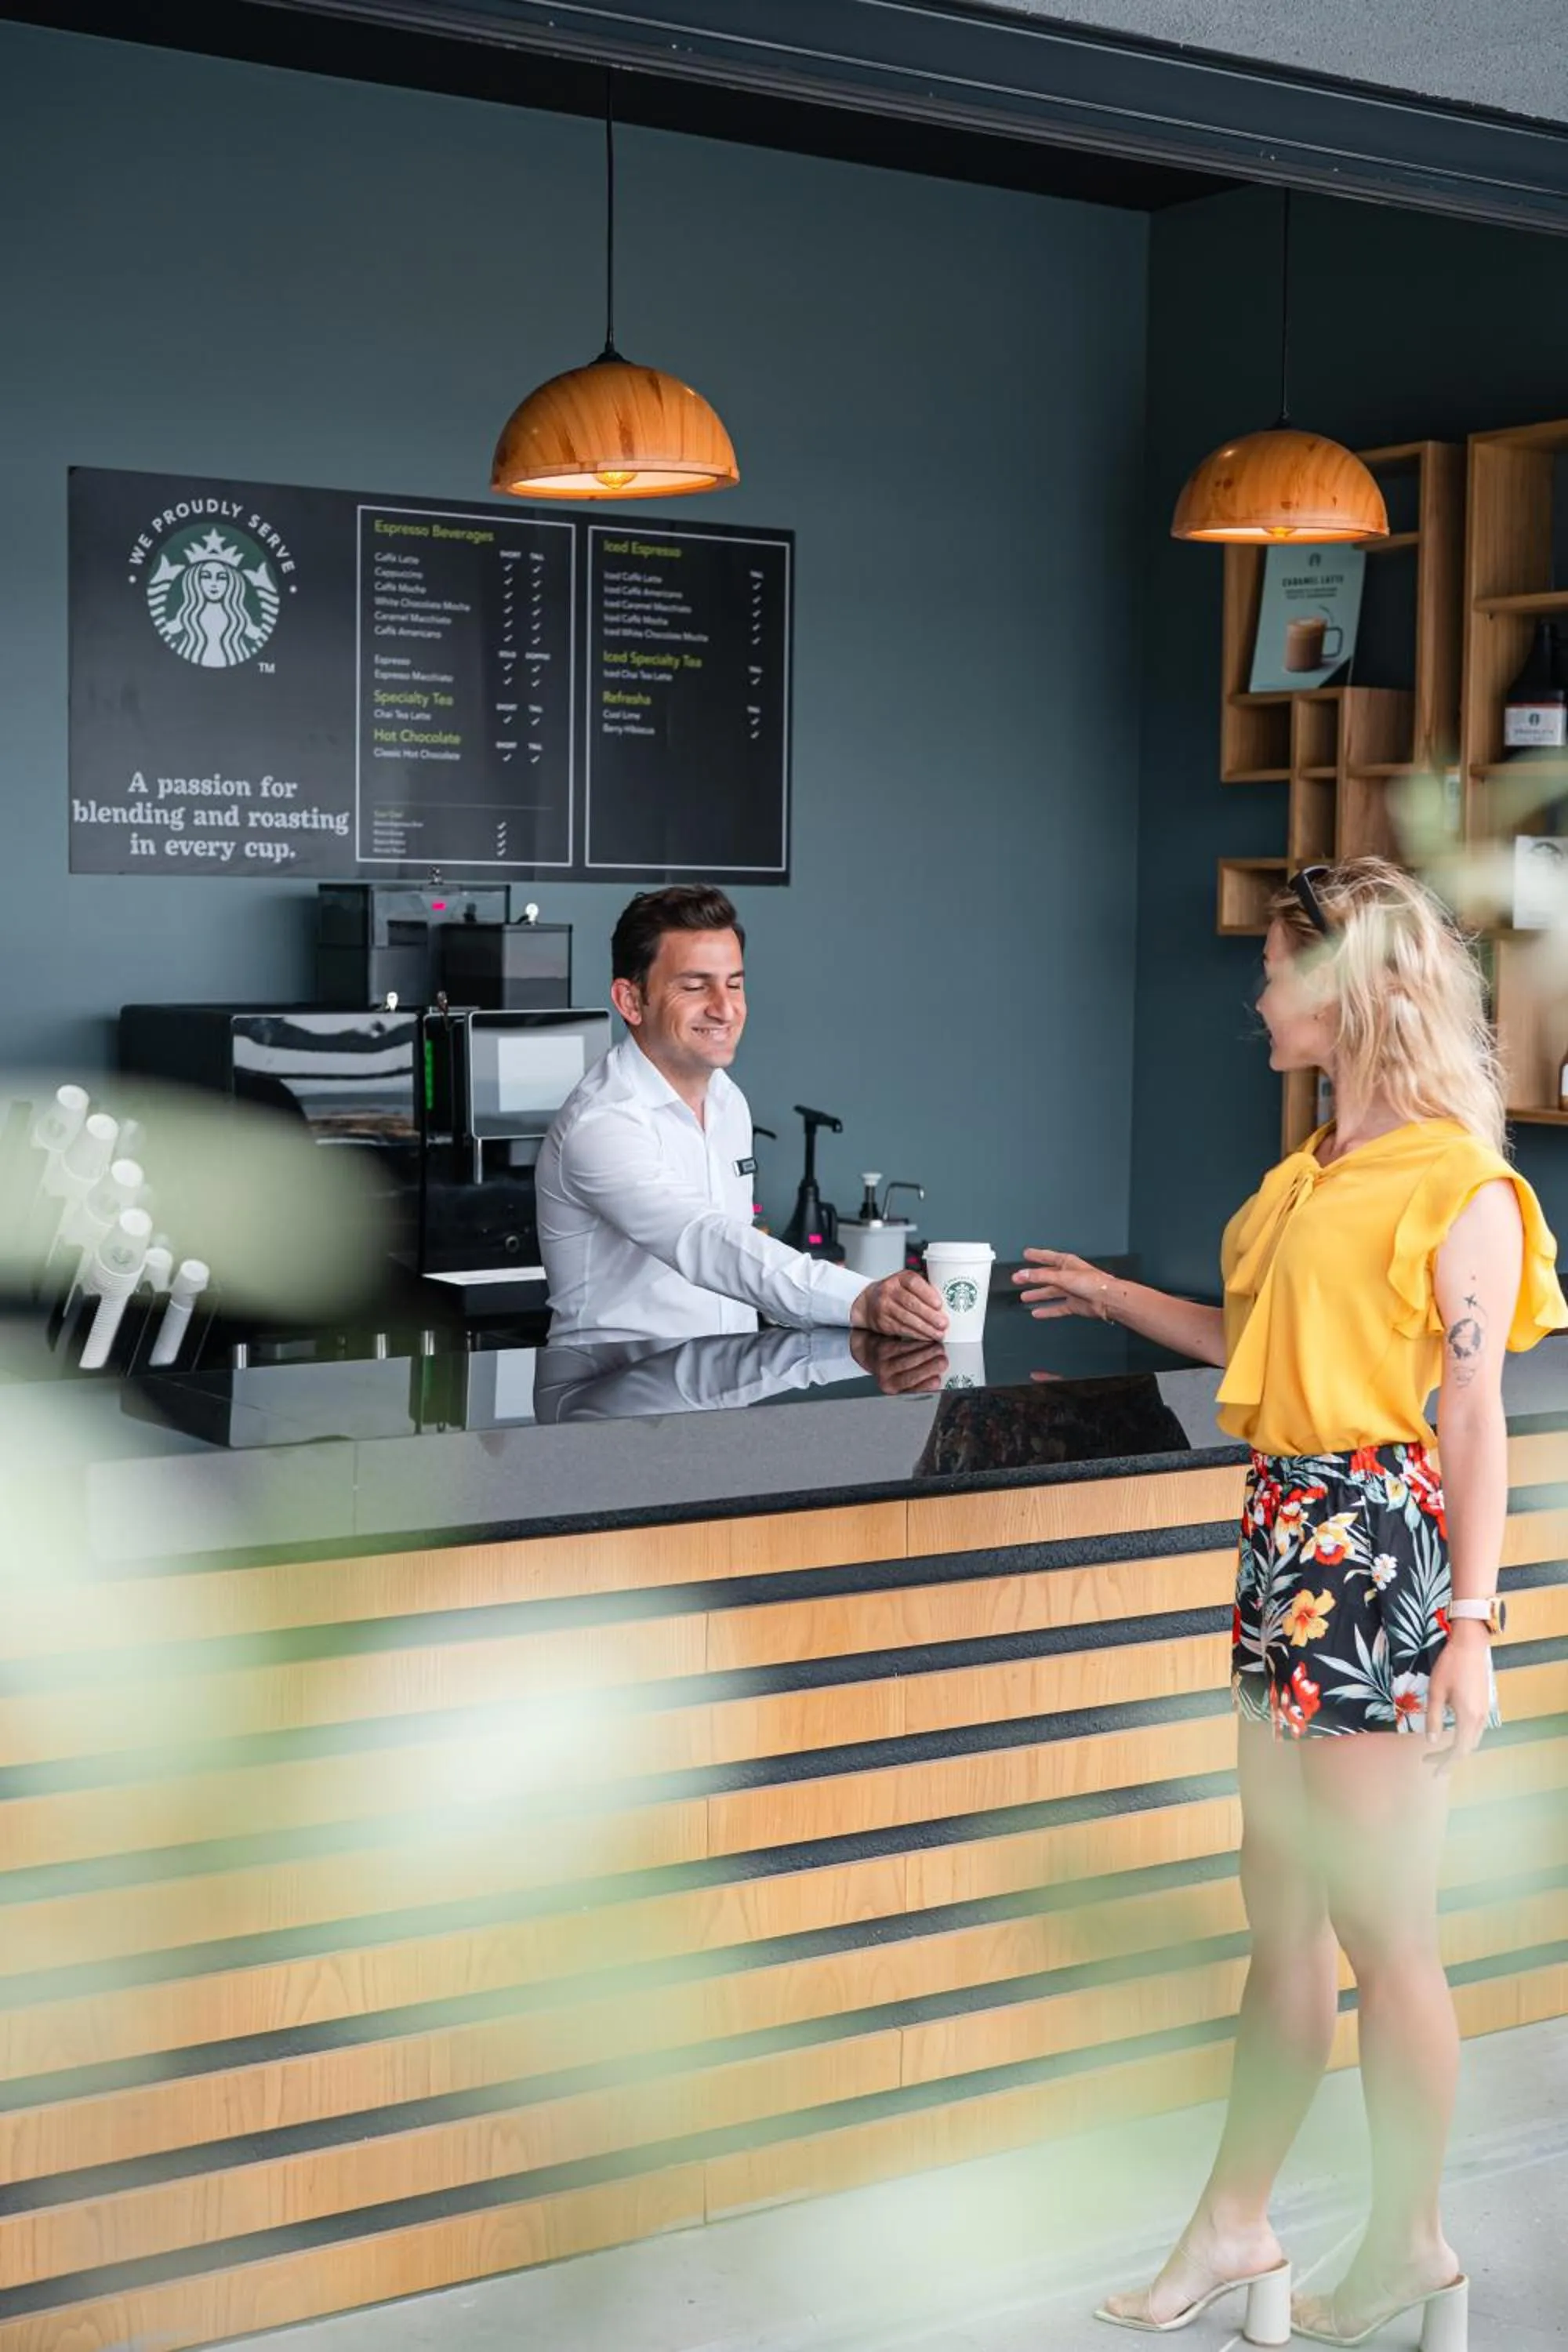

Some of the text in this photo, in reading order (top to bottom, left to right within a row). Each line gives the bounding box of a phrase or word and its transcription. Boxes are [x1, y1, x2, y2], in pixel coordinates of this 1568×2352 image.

[129, 499, 296, 574] WE PROUDLY SERVE
[374, 520, 495, 544] Espresso Beverages
[603, 540, 682, 558] Iced Espresso
[374, 567, 423, 579] Cappuccino
[258, 662, 275, 673] TM
[374, 654, 411, 666] Espresso
[603, 650, 702, 670] Iced Specialty Tea
[374, 669, 410, 681] Espresso
[373, 690, 454, 708] Specialty Tea
[374, 728, 461, 745] Hot Chocolate
[128, 771, 297, 798] A passion for
[72, 800, 350, 835] blending and roasting
[130, 833, 296, 862] in every cup.
